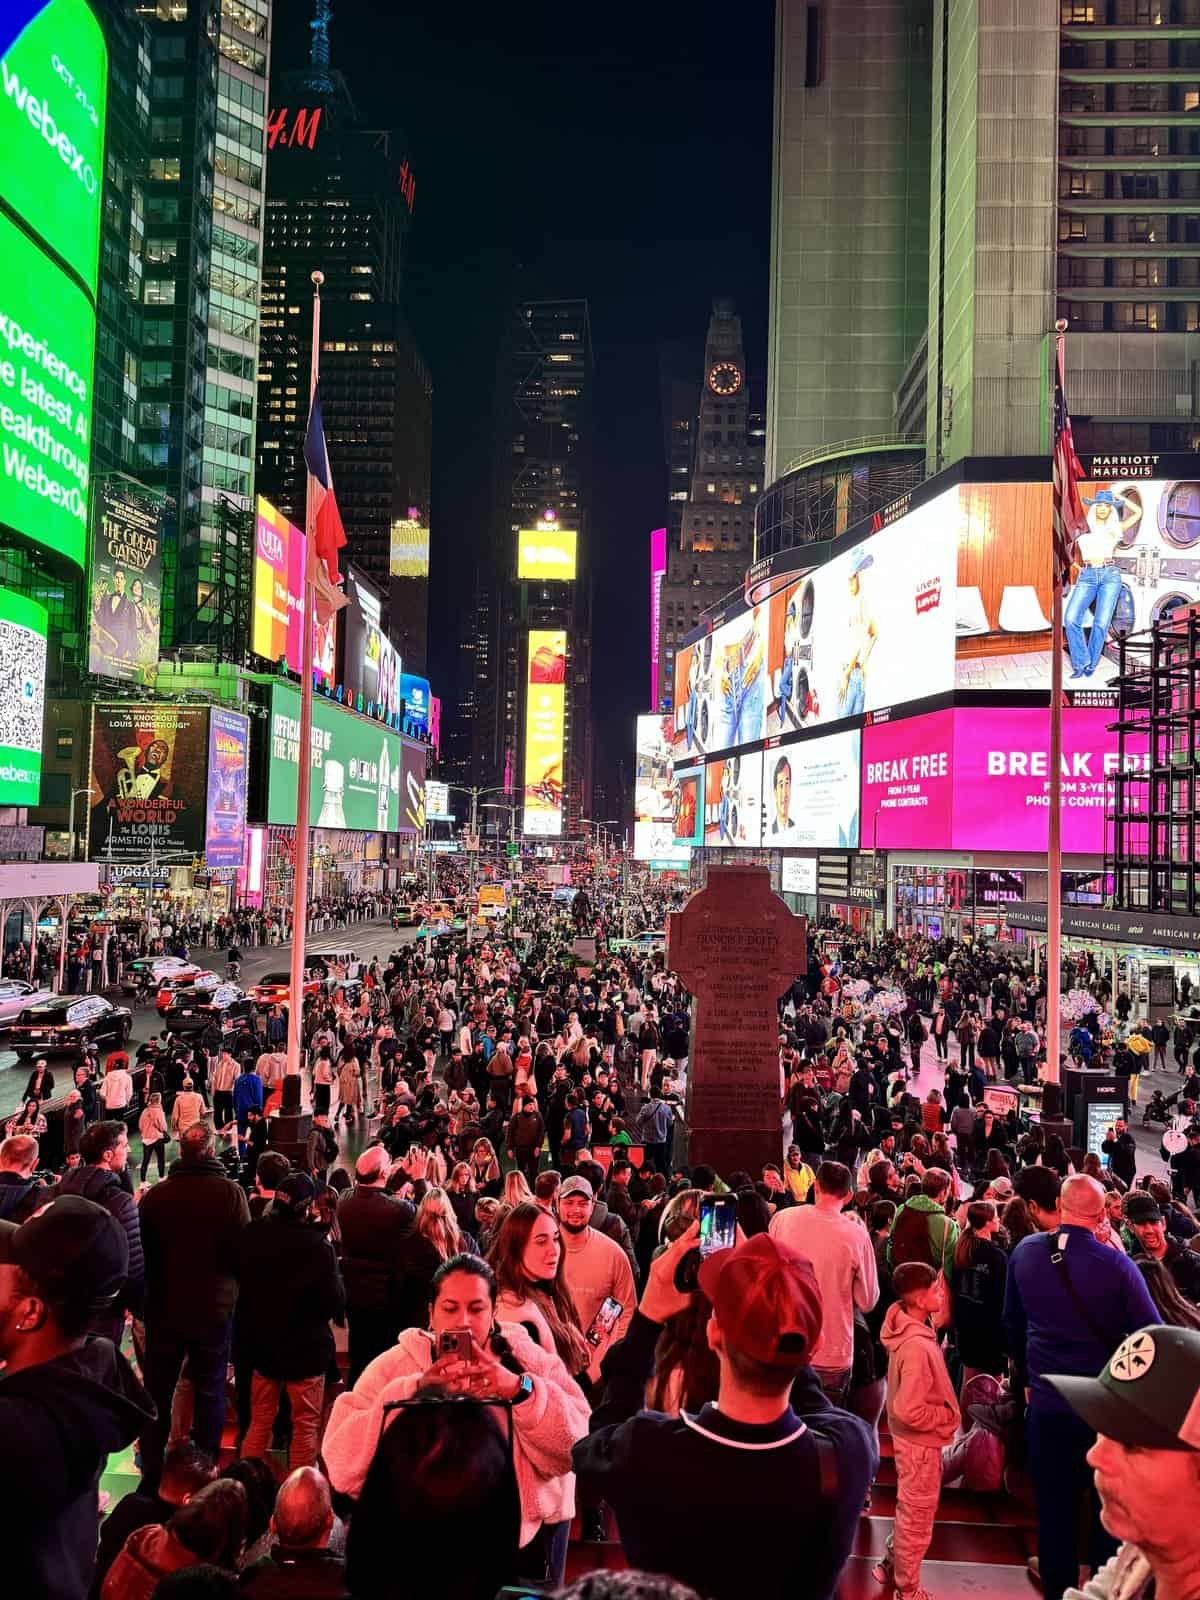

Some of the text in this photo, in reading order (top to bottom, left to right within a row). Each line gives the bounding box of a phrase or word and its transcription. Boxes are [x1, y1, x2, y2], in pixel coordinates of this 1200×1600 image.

[52, 54, 74, 88] OCT
[267, 103, 322, 150] H&M
[21, 367, 72, 430] latest
[1092, 455, 1160, 465] MARRIOTT
[1092, 466, 1151, 476] MARQUIS
[103, 516, 121, 541] THE
[124, 528, 158, 556] GREAT
[108, 540, 152, 569] GATSBY
[109, 720, 133, 728] LOUIS
[274, 713, 301, 740] OFFICIA
[273, 736, 287, 760] THE
[867, 758, 909, 784] BREAK
[912, 751, 948, 779] FREE
[1044, 783, 1118, 793] FOM 3-YEA
[117, 799, 186, 810] WONDERFUL
[1026, 796, 1139, 808] PHOE CONTRATS
[117, 810, 177, 824] WORLD
[131, 824, 171, 836] LOUIS
[105, 836, 166, 846] ARMSTRONG
[1031, 914, 1047, 924] EAGLE
[1070, 919, 1100, 929] AMERICAN
[1102, 923, 1121, 932] EAGLE
[1152, 928, 1190, 939] AMERICAN
